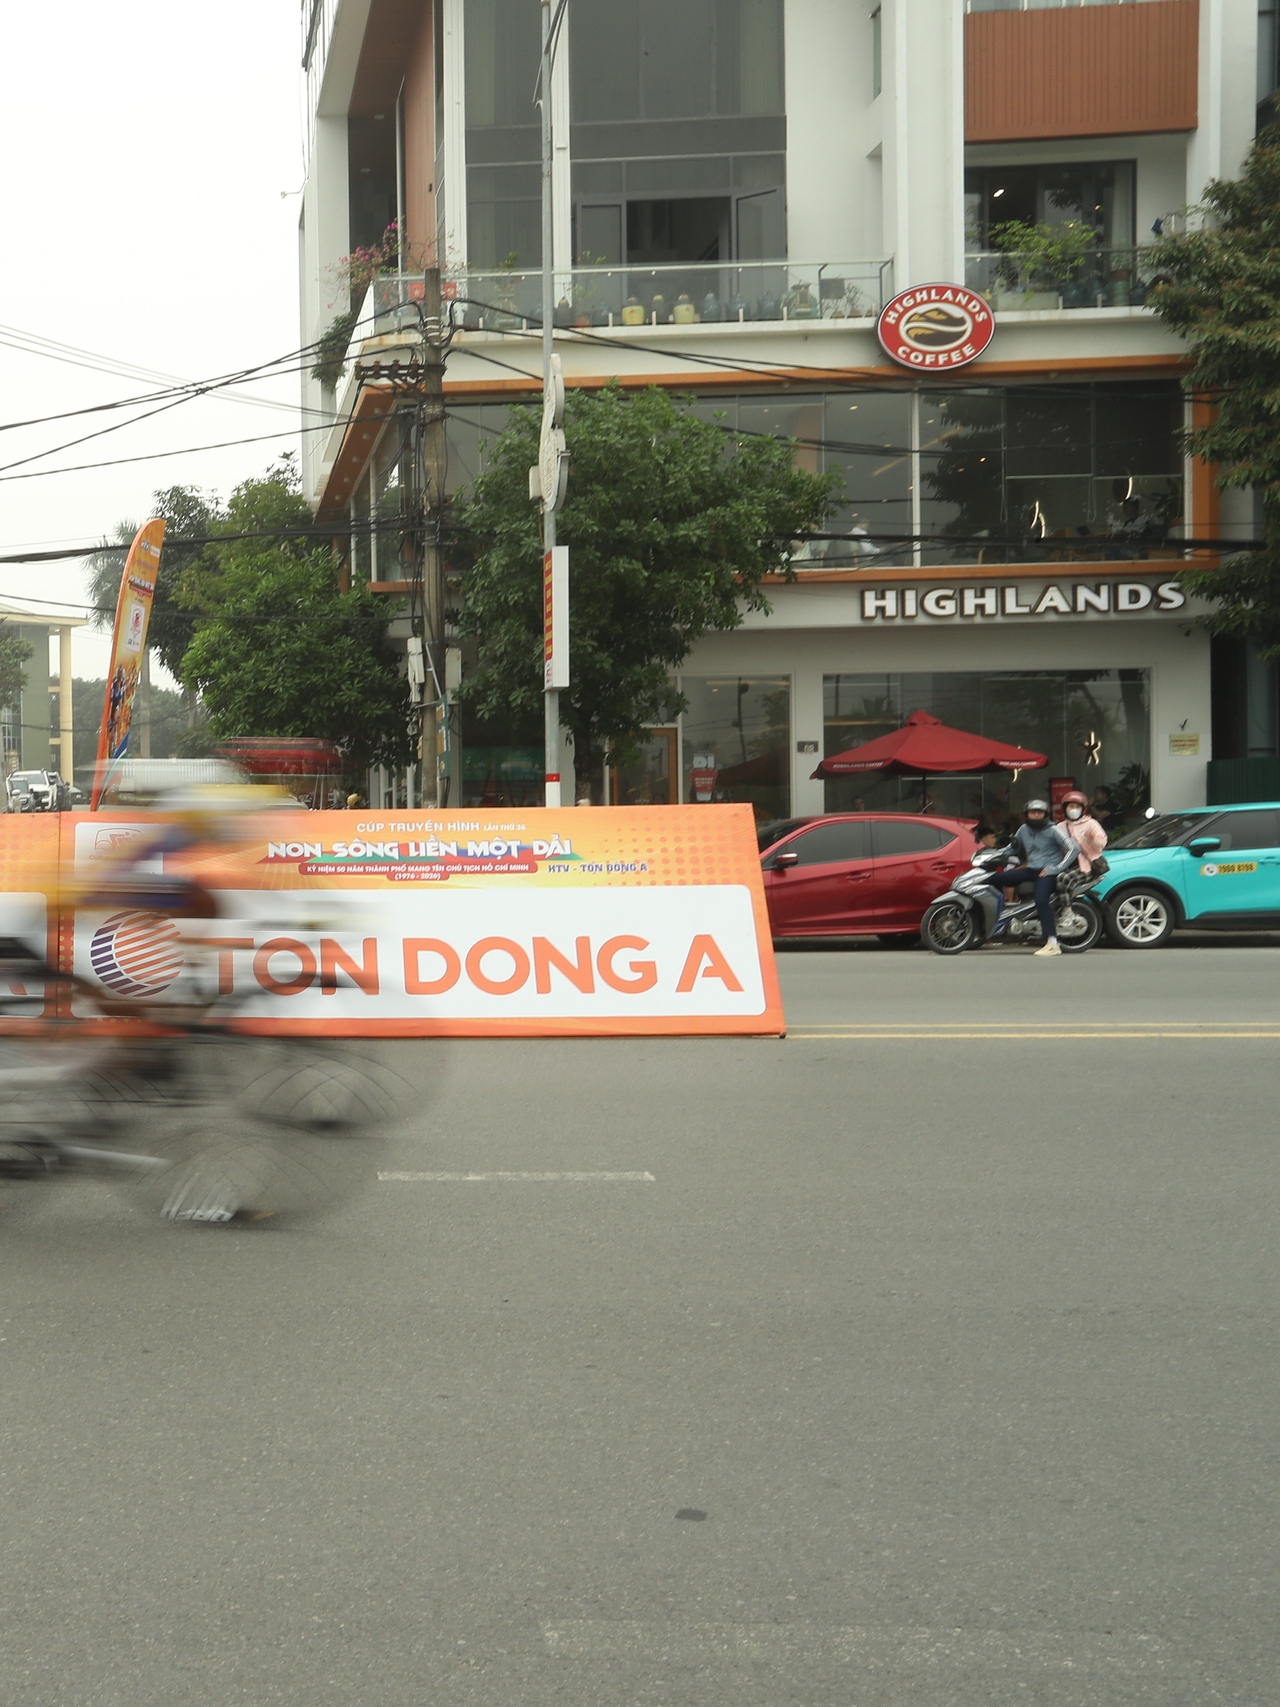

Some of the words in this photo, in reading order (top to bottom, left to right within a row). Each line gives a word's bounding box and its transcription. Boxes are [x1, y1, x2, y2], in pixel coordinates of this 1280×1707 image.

[885, 288, 988, 325] HIGHLANDS
[897, 343, 976, 365] COFFEE
[861, 581, 1186, 618] HIGHLANDS
[356, 821, 384, 832] CÚP
[388, 819, 443, 832] TRUYỀN
[447, 820, 481, 831] HÌNH
[268, 841, 322, 859] NON
[333, 838, 400, 860] SÔNG
[408, 833, 458, 858] LIỀN
[467, 836, 521, 860] MỘT
[532, 833, 573, 859] DẢI
[548, 863, 570, 873] HTV
[198, 937, 379, 996] TON
[402, 934, 658, 996] DONG
[674, 933, 745, 993] A
